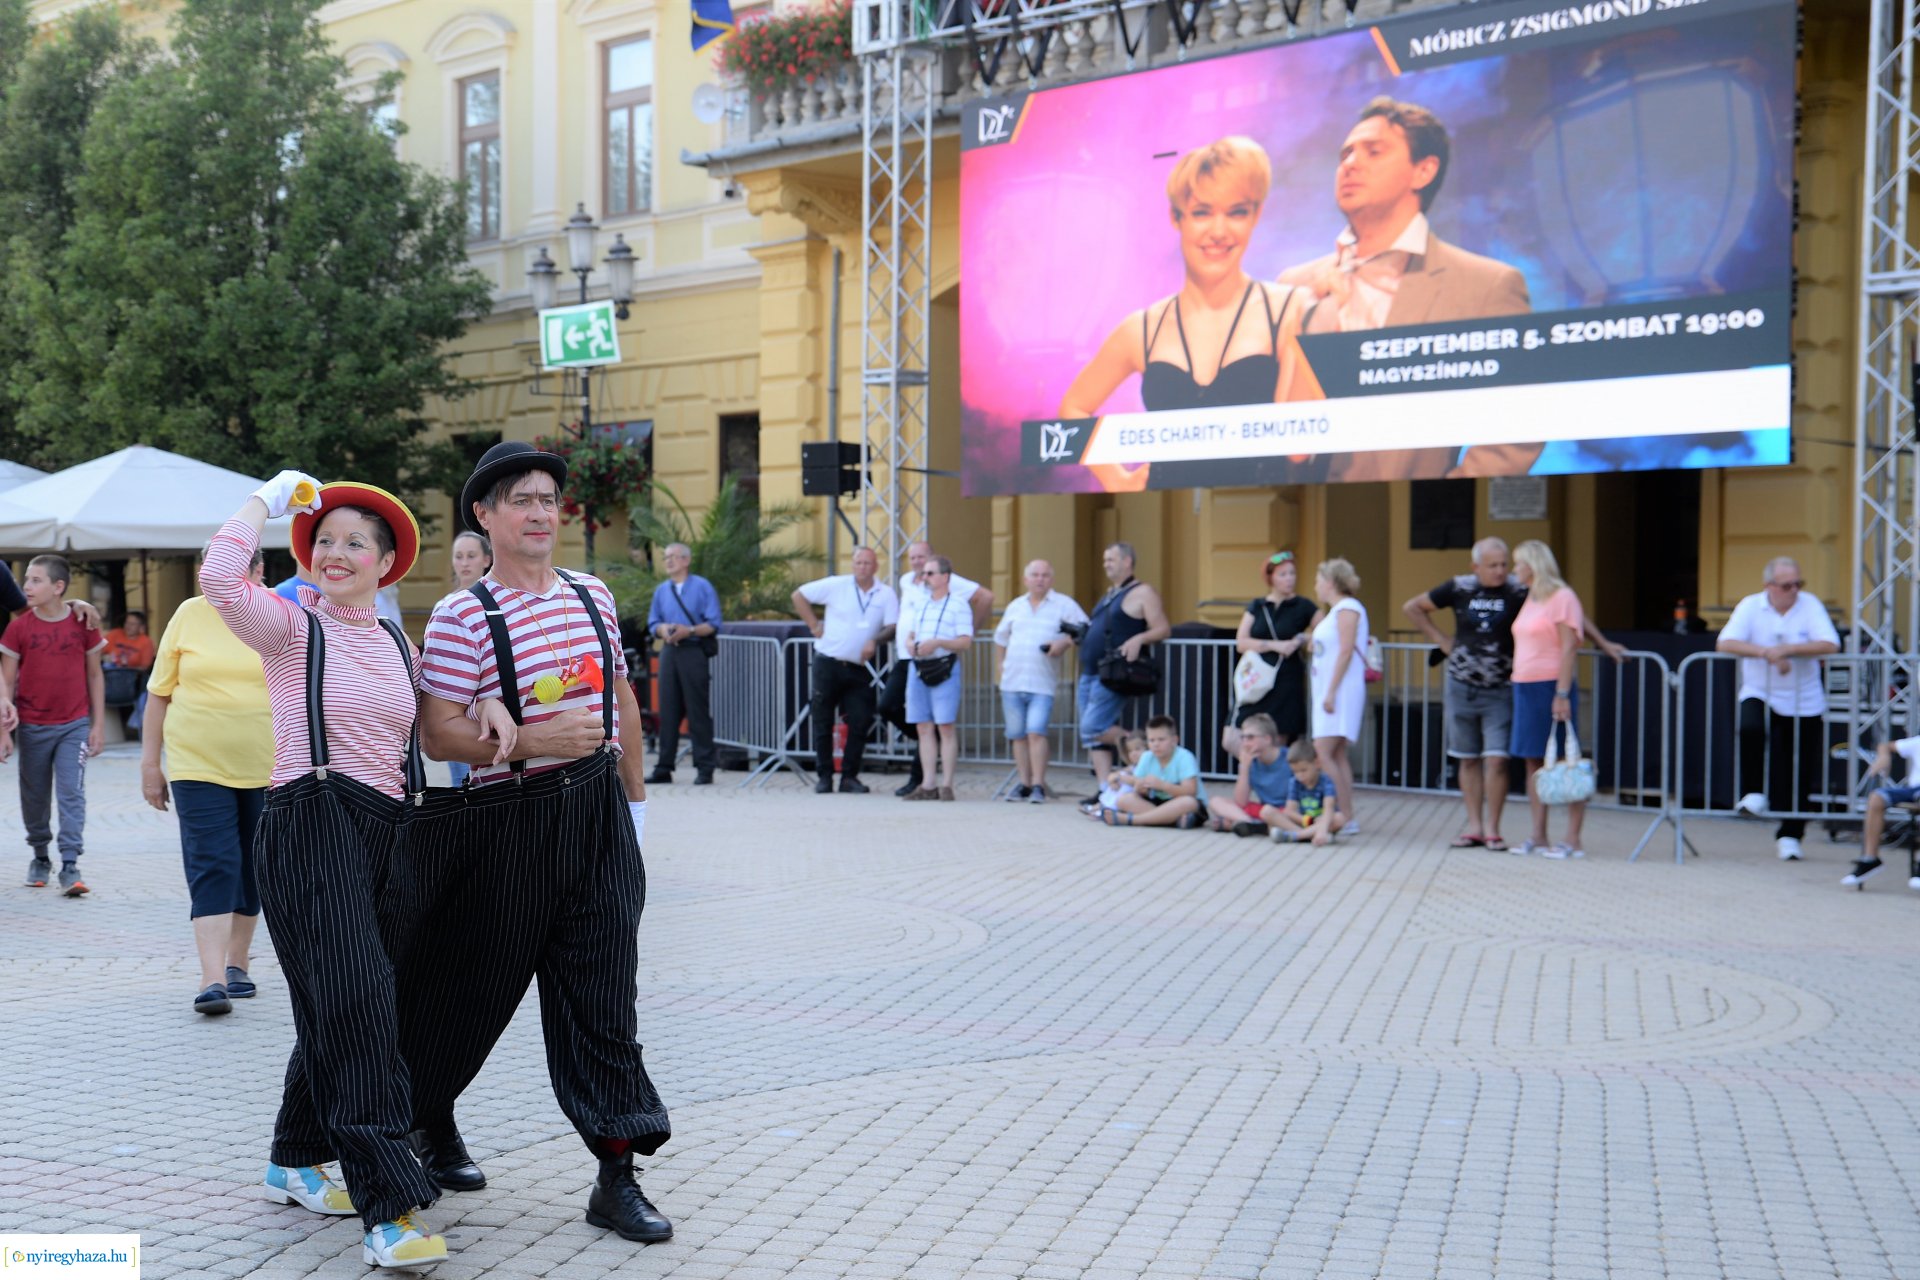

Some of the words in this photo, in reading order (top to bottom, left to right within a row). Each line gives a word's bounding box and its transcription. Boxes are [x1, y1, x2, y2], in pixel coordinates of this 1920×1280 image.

[1409, 21, 1505, 58] MÓRICZ
[1510, 0, 1651, 39] ZSIGMOND
[1359, 328, 1518, 361] SZEPTEMBER
[1523, 329, 1546, 350] 5.
[1550, 313, 1682, 344] SZOMBAT
[1685, 308, 1765, 335] 19:00
[1359, 360, 1500, 385] NAGYSZÍNPAD
[1159, 424, 1227, 443] CHARITY
[1468, 598, 1505, 612] NIKE
